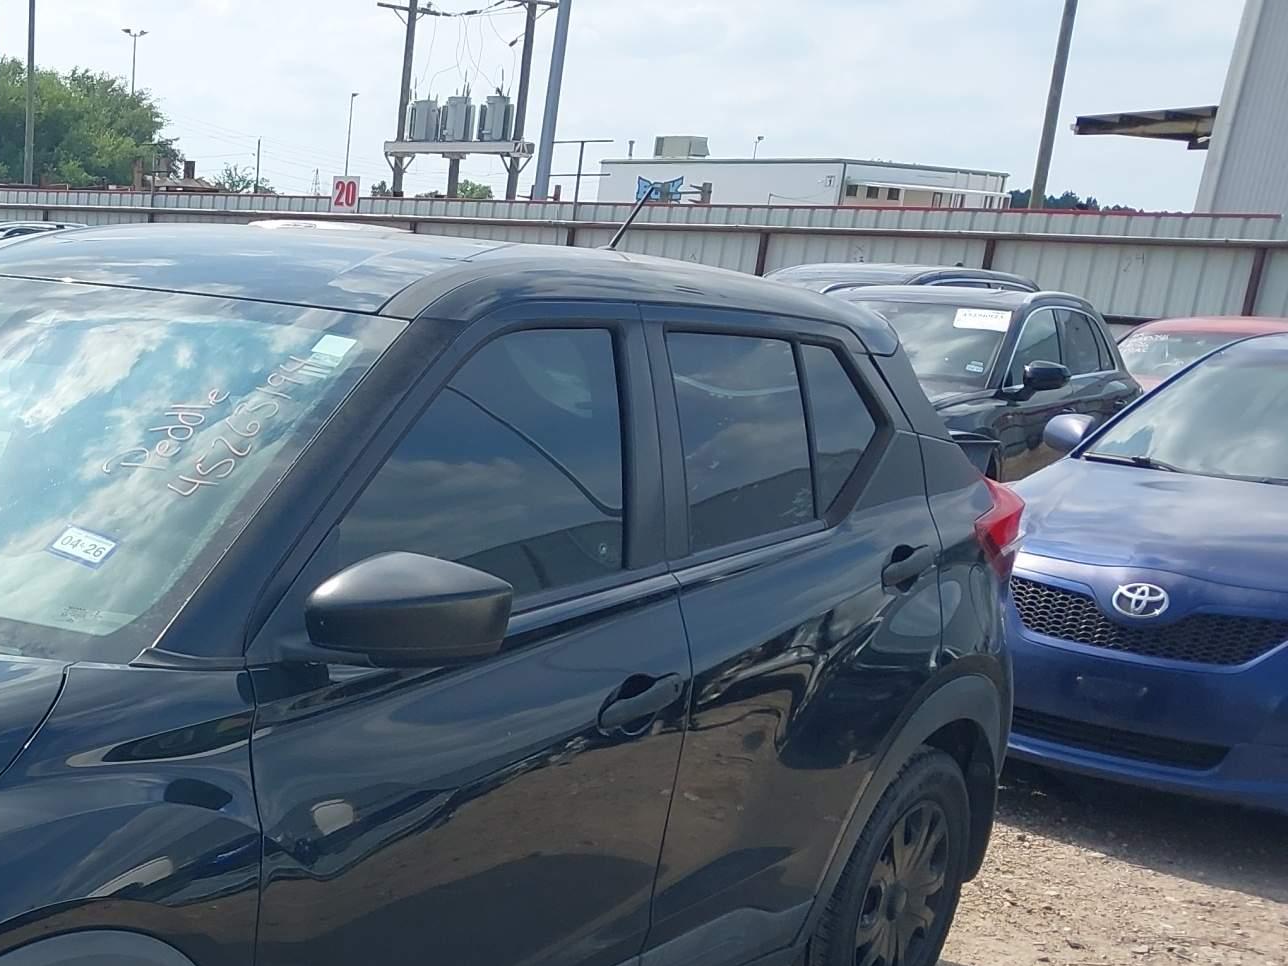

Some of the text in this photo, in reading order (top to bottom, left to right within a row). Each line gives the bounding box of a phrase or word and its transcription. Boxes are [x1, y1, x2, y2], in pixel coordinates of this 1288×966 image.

[334, 180, 357, 207] 20
[102, 388, 230, 474] Peddle
[167, 355, 316, 496] 45263194
